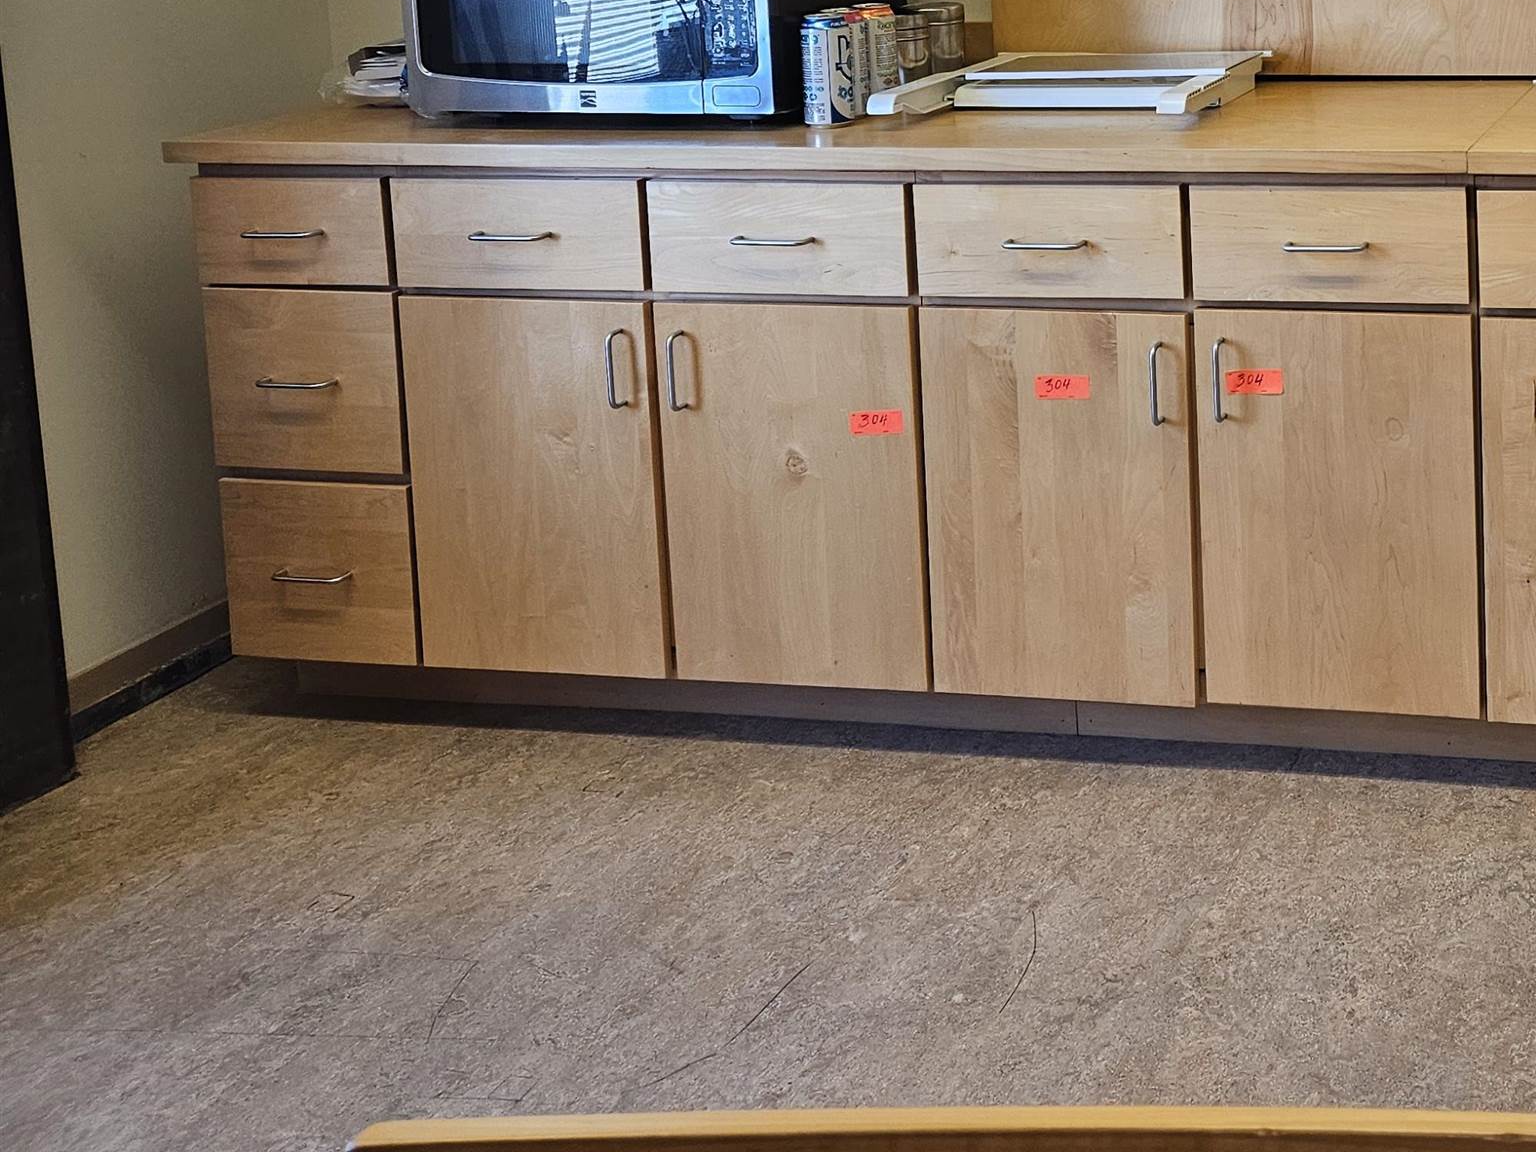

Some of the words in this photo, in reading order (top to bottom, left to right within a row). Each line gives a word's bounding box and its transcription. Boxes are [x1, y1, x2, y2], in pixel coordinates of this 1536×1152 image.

[1045, 378, 1072, 393] 304
[1236, 372, 1264, 388] 304
[858, 414, 888, 428] 304
